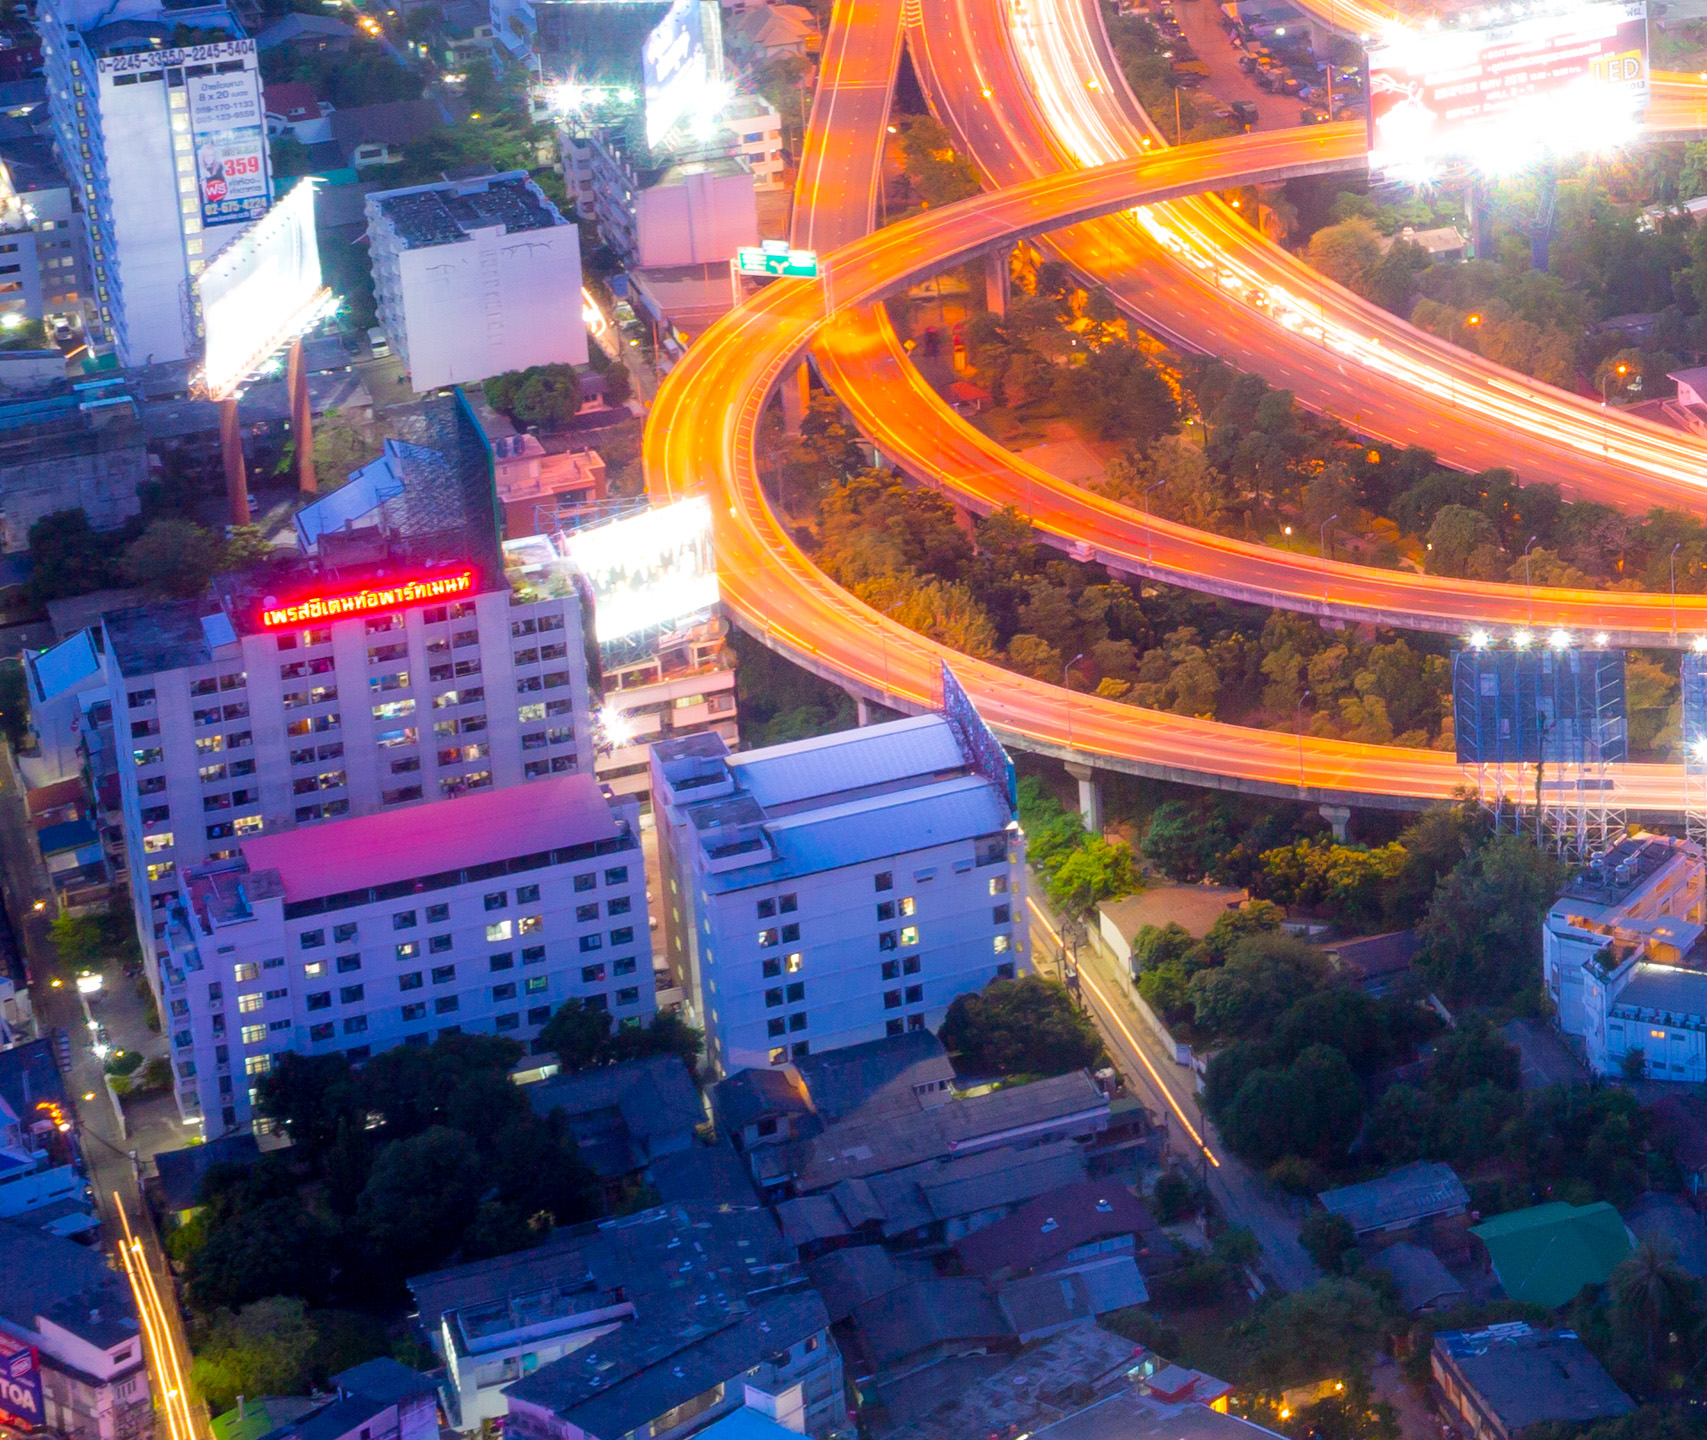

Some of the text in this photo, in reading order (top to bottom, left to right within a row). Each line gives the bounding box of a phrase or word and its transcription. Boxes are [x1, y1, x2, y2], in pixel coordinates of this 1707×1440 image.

[216, 90, 229, 99] 20
[223, 156, 259, 177] 359
[0, 1377, 37, 1413] TOA
